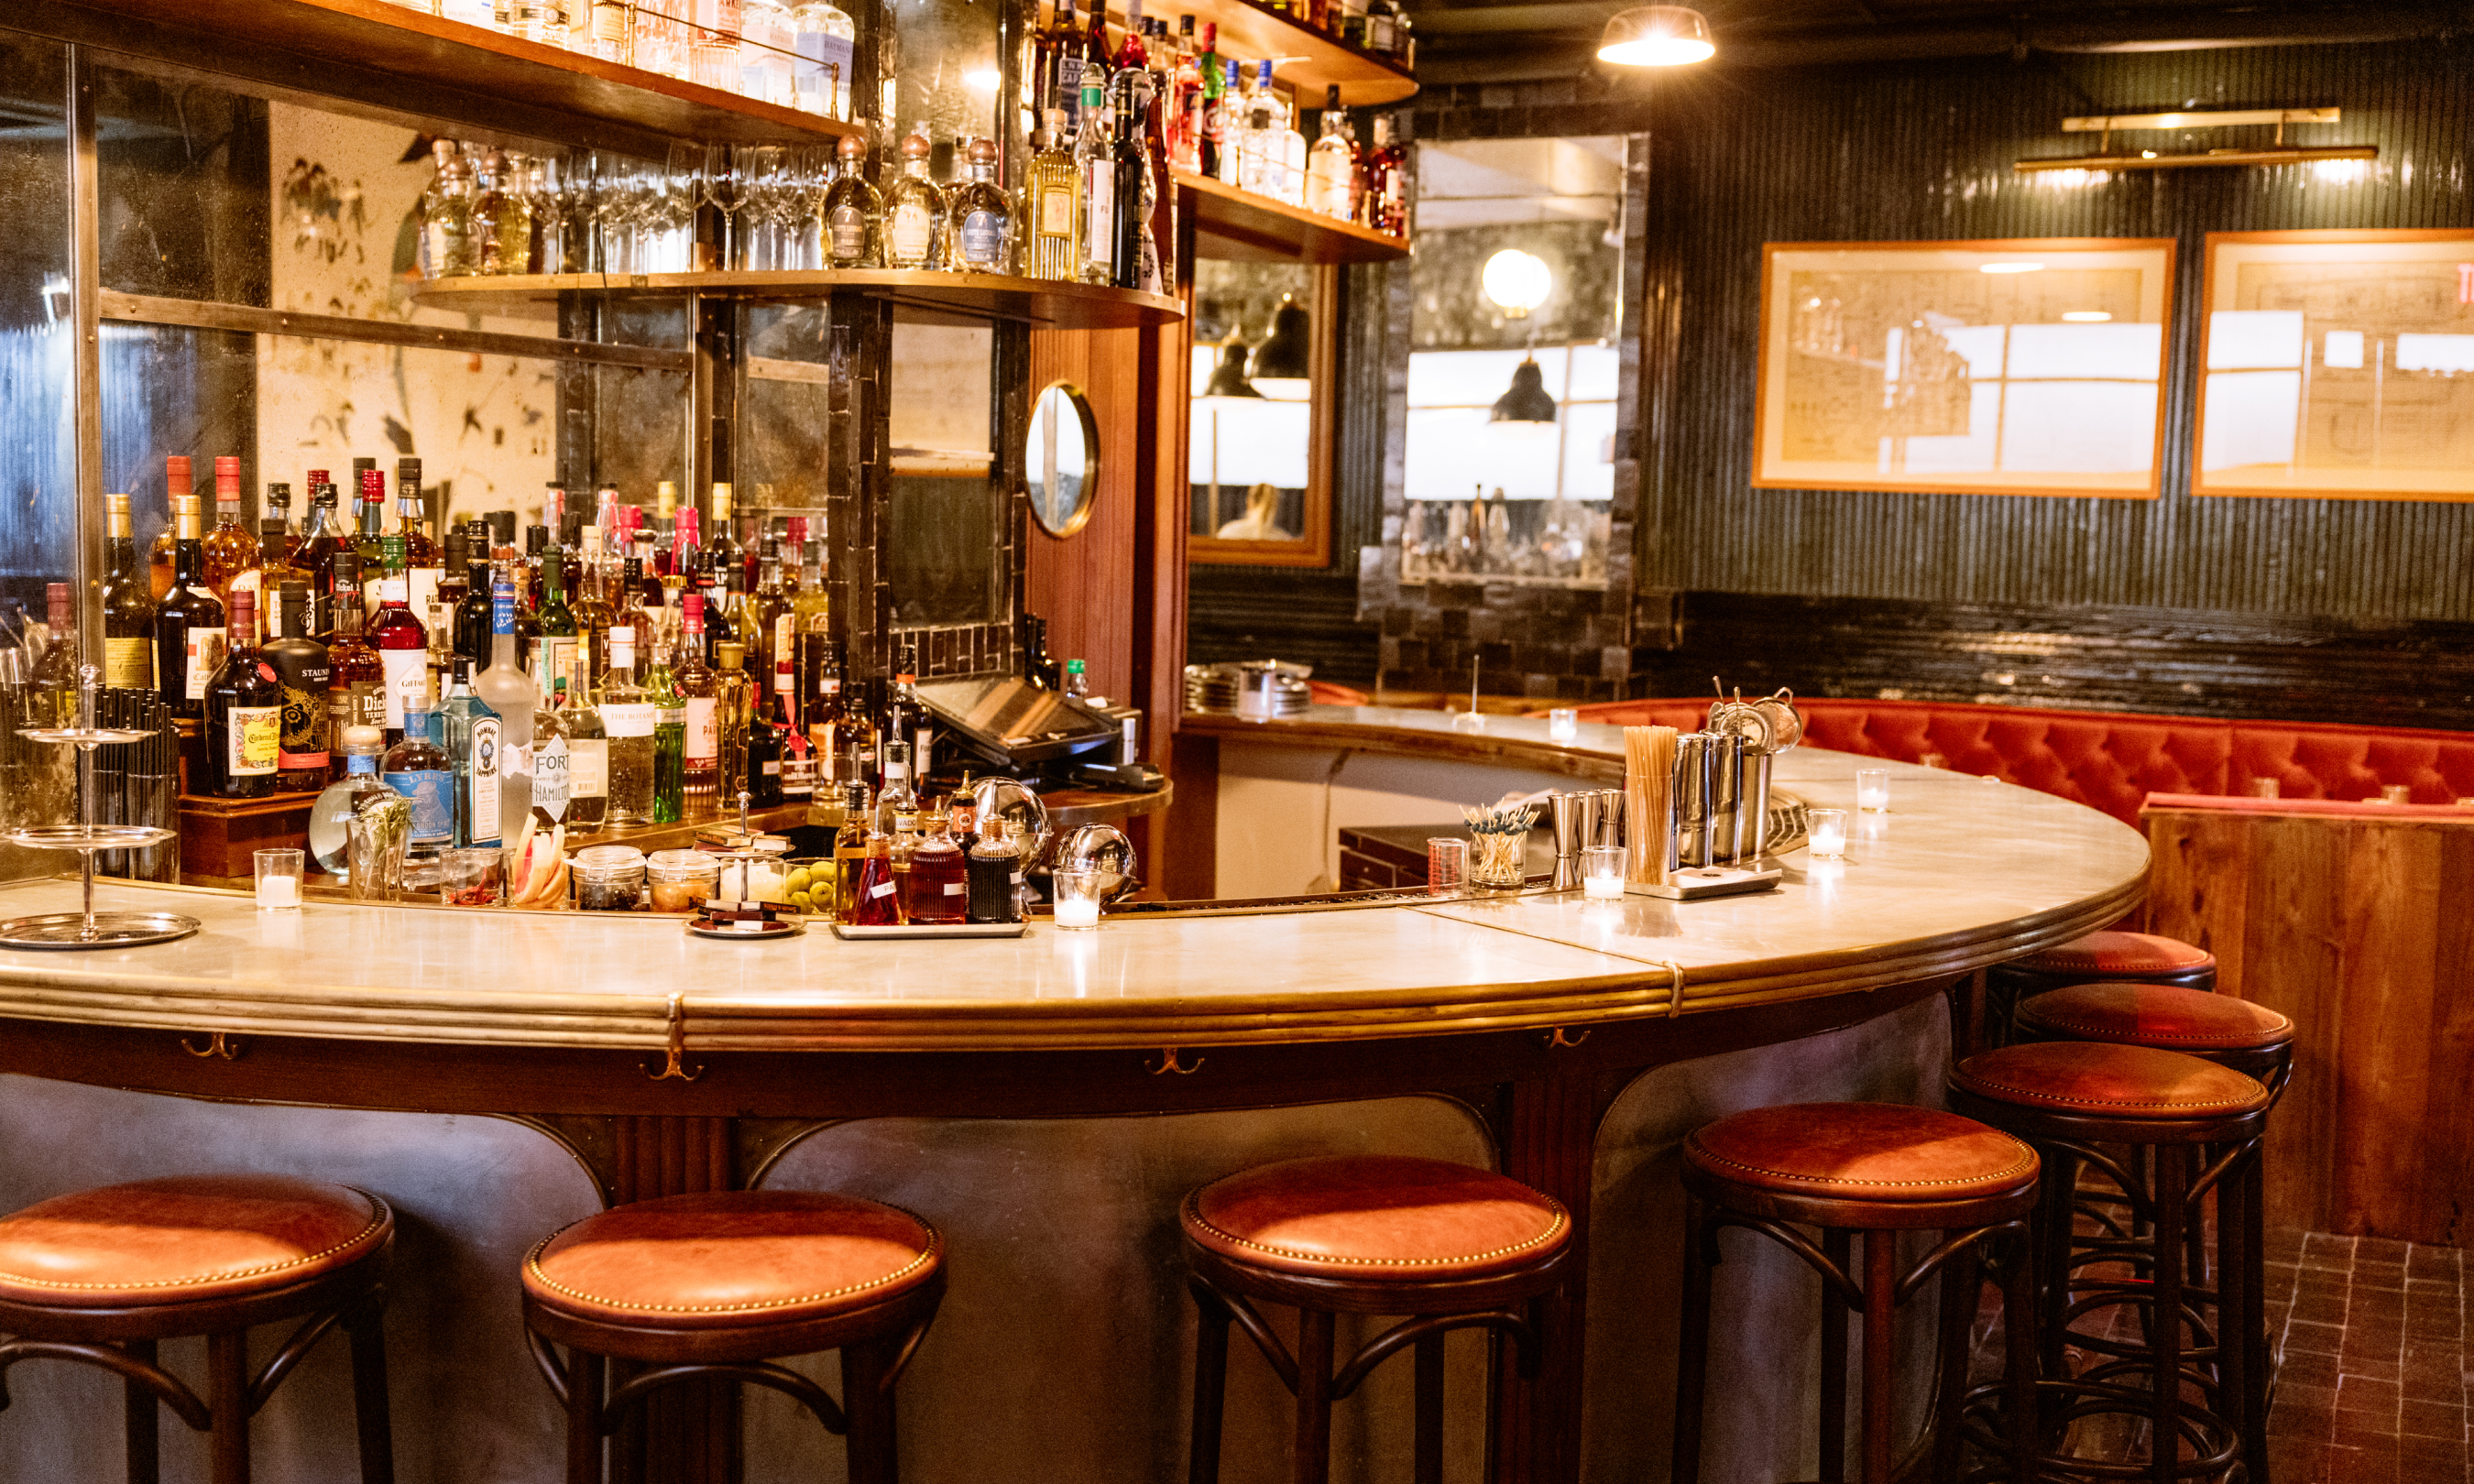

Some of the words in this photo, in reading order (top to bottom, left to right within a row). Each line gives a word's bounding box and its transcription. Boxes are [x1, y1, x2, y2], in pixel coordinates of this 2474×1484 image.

[844, 210, 852, 223] 7
[977, 213, 986, 226] 7
[476, 726, 496, 738] BOMBAY
[476, 764, 497, 778] SAPPHIRE
[536, 754, 569, 775] FORT
[415, 821, 436, 829] ONDON
